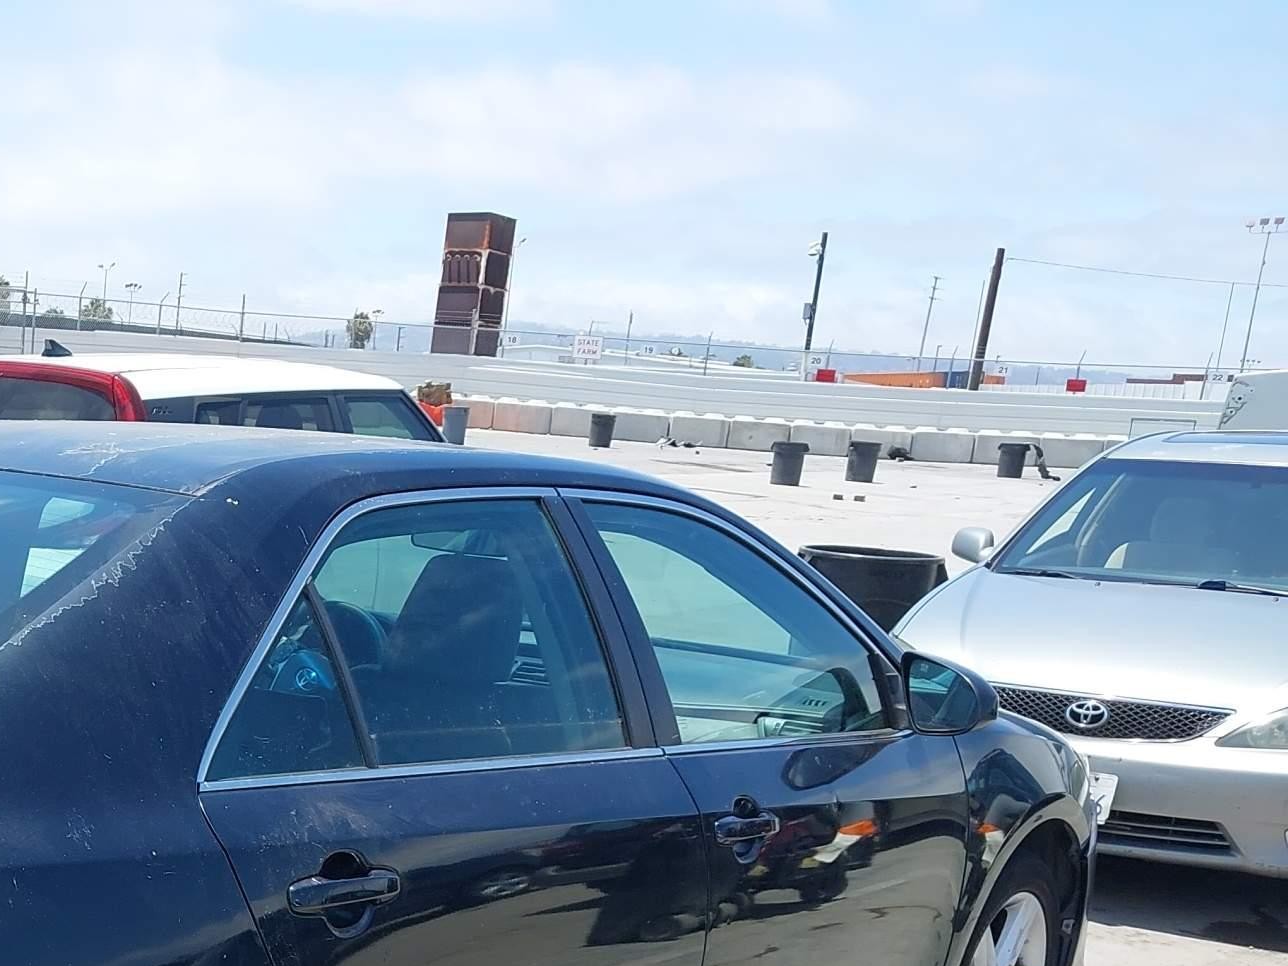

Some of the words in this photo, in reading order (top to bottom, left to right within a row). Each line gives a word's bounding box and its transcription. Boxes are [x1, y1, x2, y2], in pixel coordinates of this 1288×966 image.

[577, 338, 600, 347] STATE
[577, 347, 598, 355] FARM
[644, 346, 654, 354] 19
[811, 357, 821, 365] 20
[998, 366, 1008, 374] 21
[1212, 374, 1224, 382] 22
